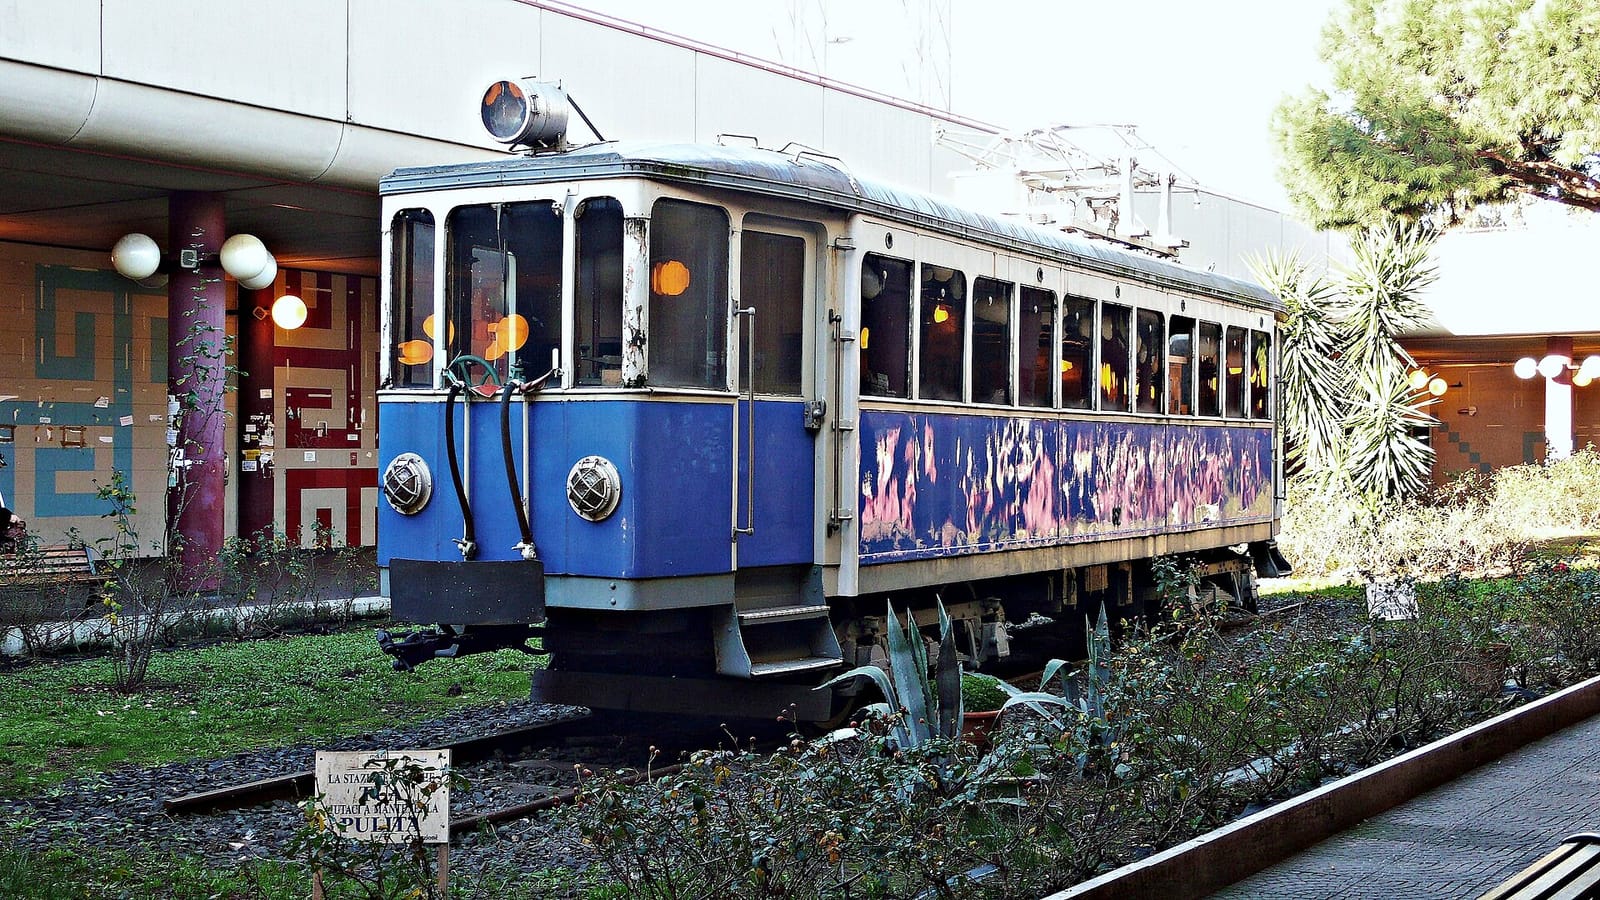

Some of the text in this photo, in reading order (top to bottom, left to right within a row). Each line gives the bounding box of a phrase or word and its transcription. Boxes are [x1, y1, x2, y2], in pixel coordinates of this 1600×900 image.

[328, 774, 341, 783] LA
[364, 805, 370, 814] A
[340, 817, 420, 832] PULITA
